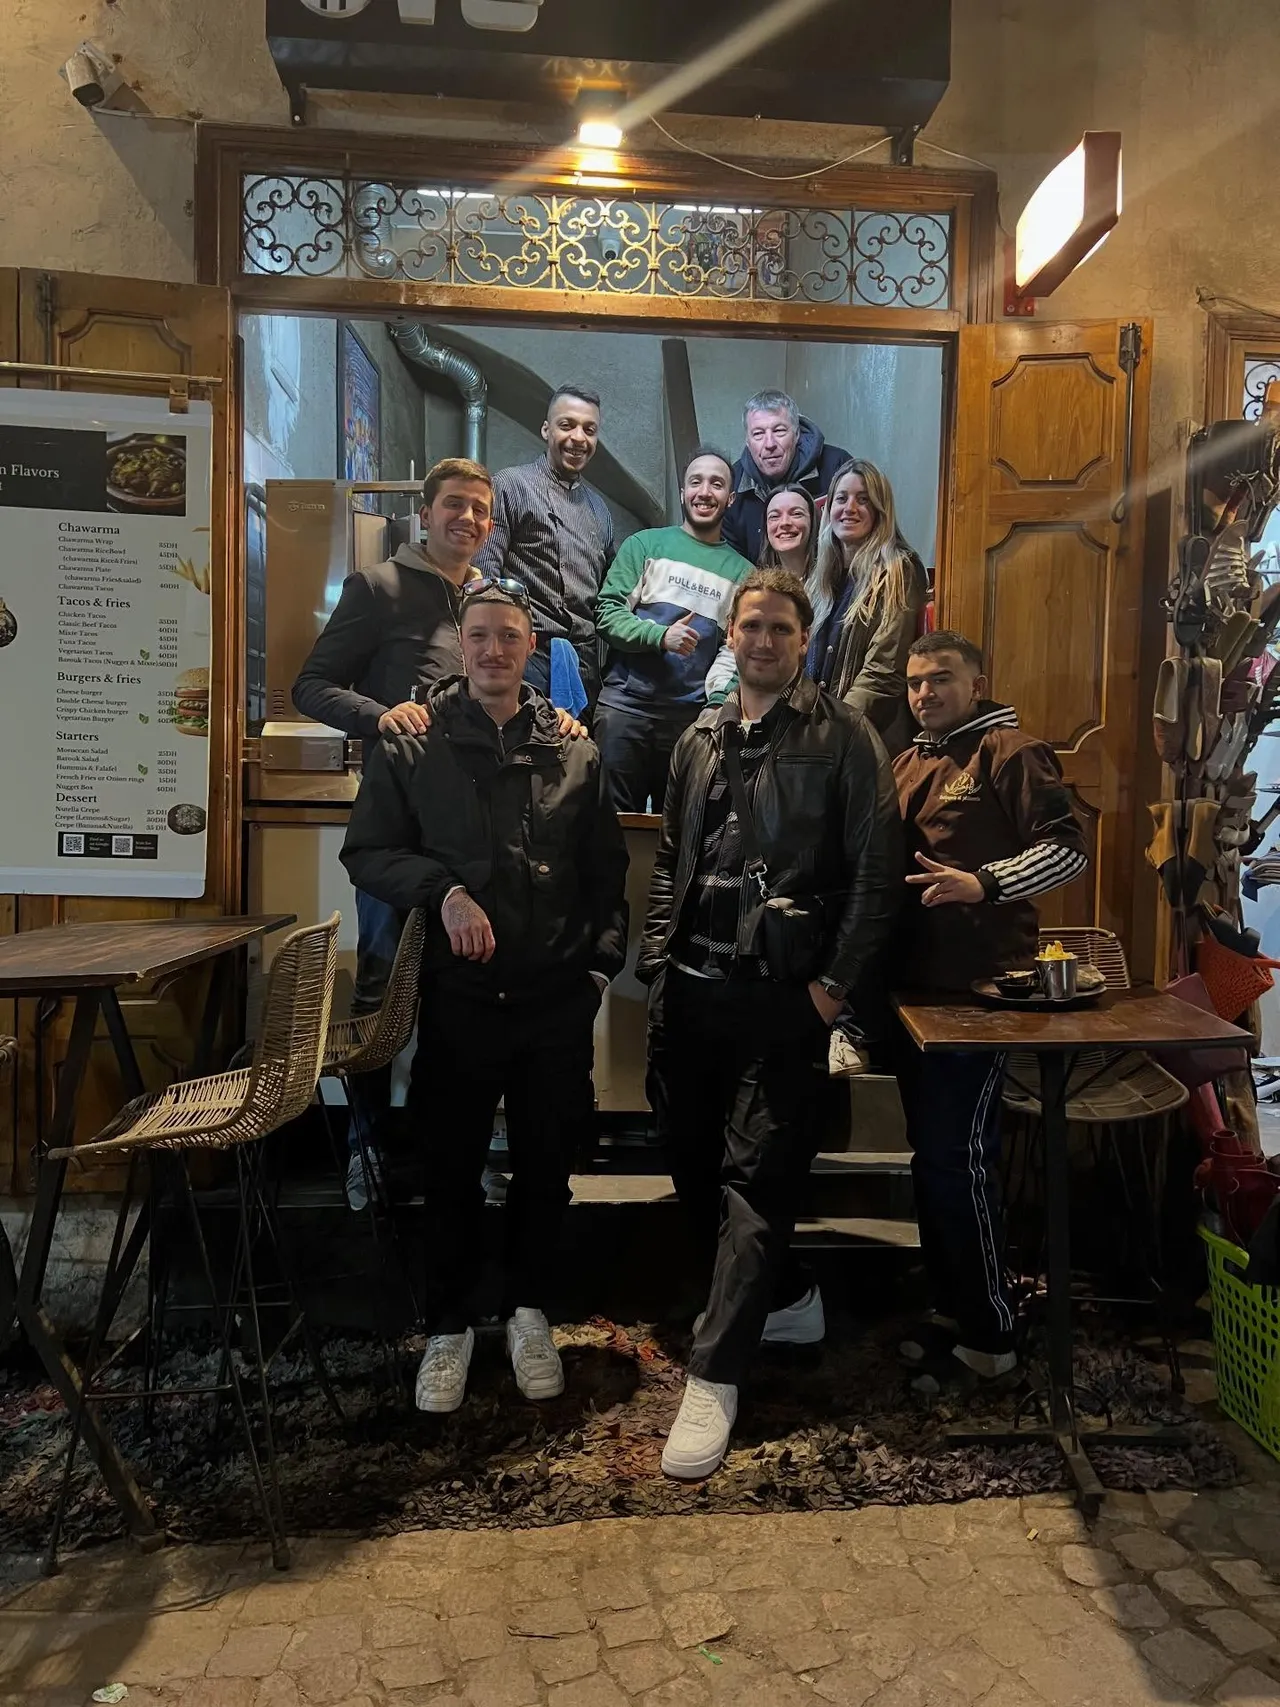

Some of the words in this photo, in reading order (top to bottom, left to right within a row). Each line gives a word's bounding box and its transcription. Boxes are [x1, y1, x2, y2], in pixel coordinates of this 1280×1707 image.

[11, 464, 60, 479] Flavors
[58, 522, 120, 534] Chawarma
[668, 576, 722, 600] PULL&BEAR
[57, 595, 90, 606] Tacos
[93, 598, 102, 607] &
[106, 598, 131, 608] fries
[57, 672, 101, 684] Burgers
[117, 674, 141, 684] fries
[56, 731, 99, 741] Starters
[56, 793, 97, 802] Dessert
